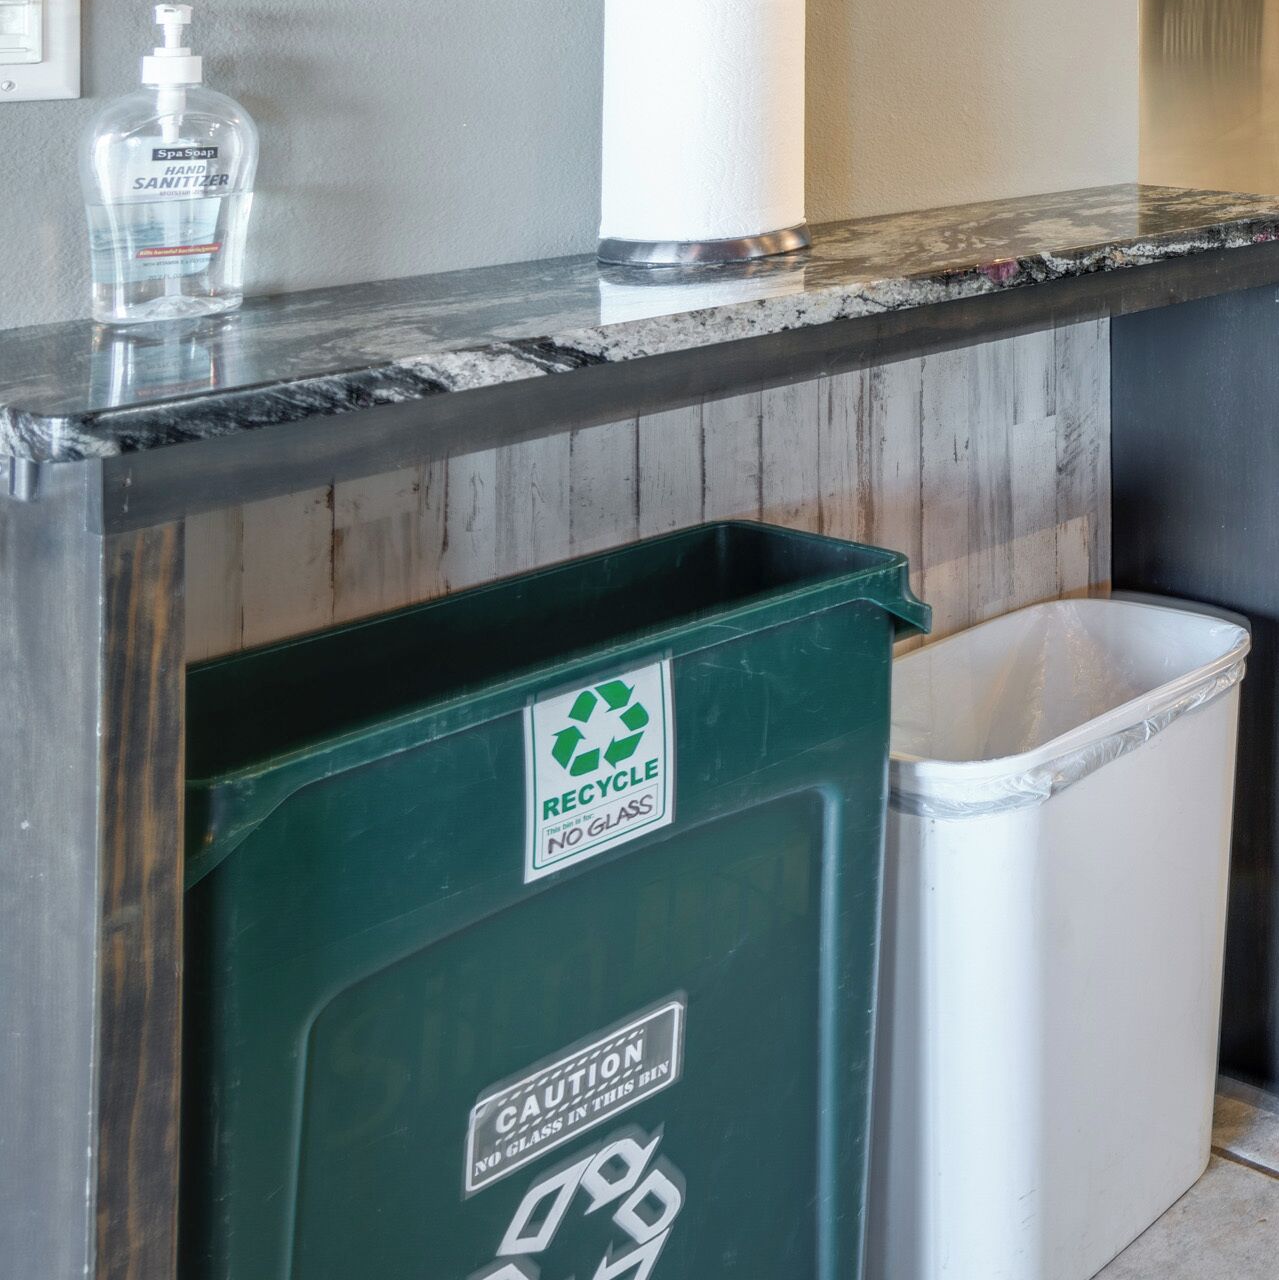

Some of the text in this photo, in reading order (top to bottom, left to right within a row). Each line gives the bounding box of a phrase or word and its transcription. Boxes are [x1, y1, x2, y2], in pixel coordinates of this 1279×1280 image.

[158, 148, 215, 160] Spa Soap
[164, 165, 206, 176] HAND
[132, 174, 230, 190] SANITIZER
[543, 757, 659, 821] RECYCLE
[546, 823, 561, 836] This
[562, 820, 574, 832] bin
[575, 818, 582, 828] is
[547, 794, 654, 854] NO GLASS
[495, 1038, 643, 1134] CAUTION
[474, 1060, 670, 1177] NO GLASS IN THIS BIN
